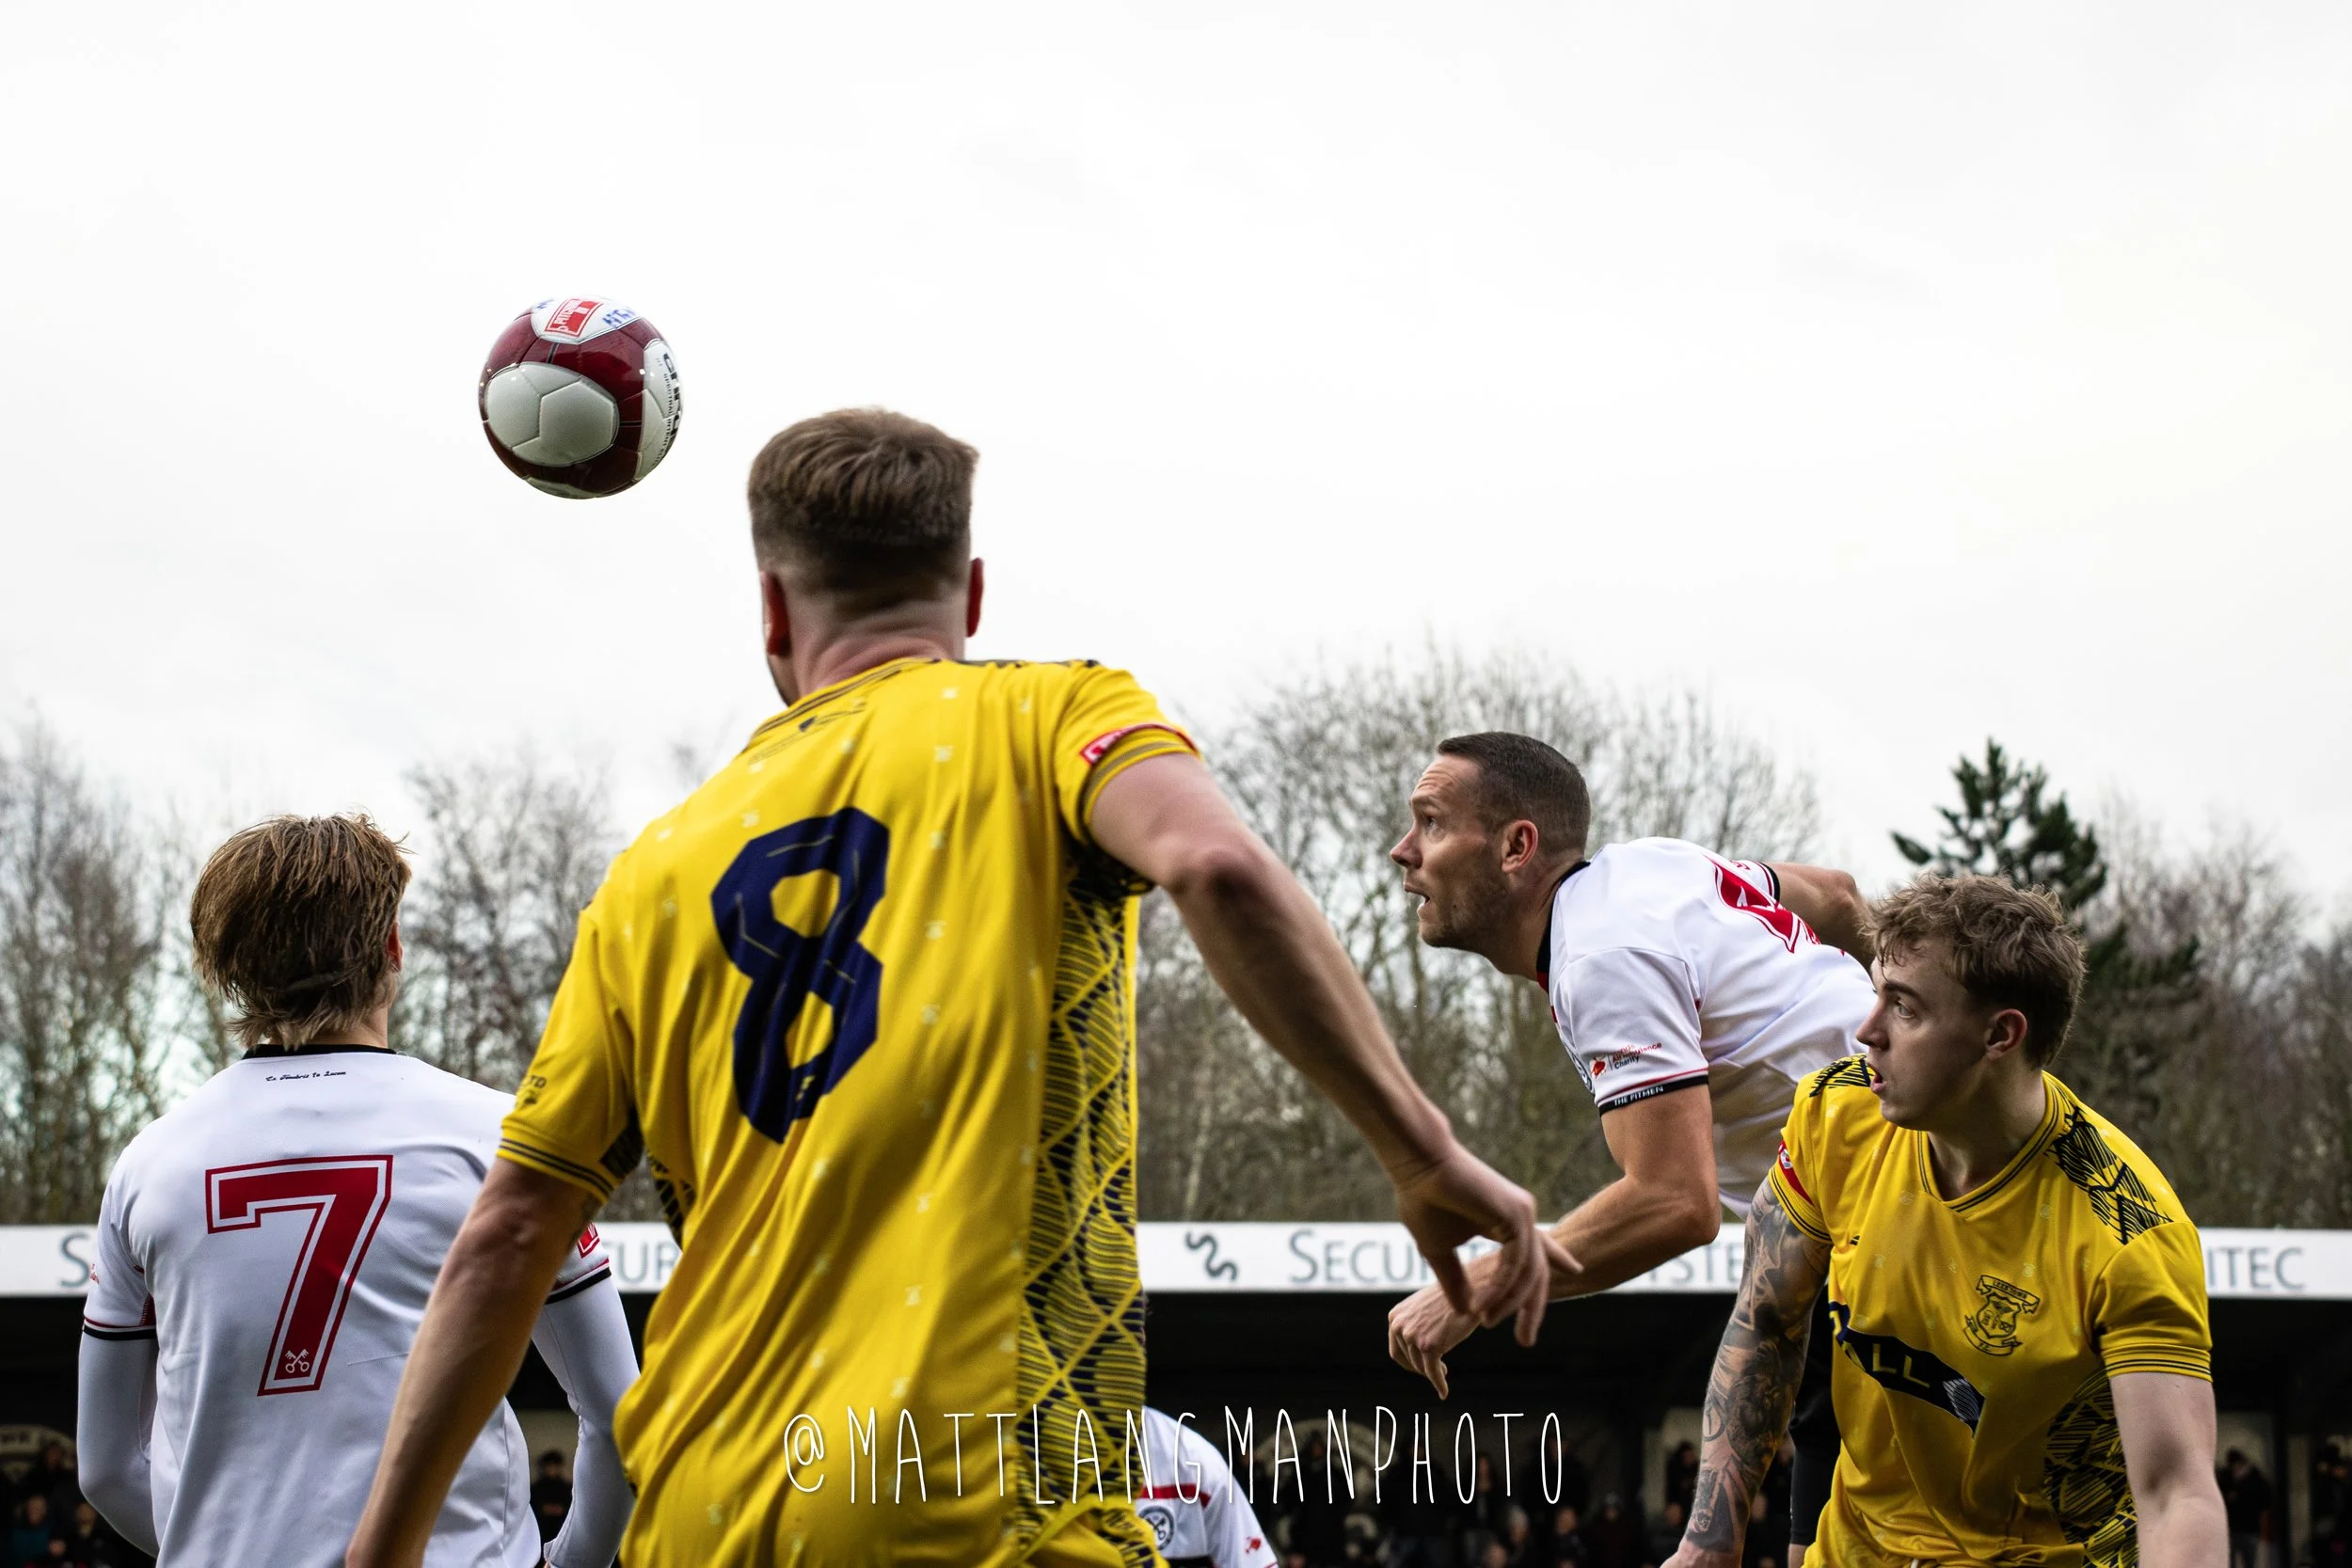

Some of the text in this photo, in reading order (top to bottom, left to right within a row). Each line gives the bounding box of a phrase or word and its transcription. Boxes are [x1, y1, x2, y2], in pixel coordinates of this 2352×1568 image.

[710, 806, 890, 1145] 8
[1613, 1096, 1629, 1106] THE
[205, 1154, 393, 1397] 7
[1288, 1227, 1430, 1285] SECU
[2206, 1246, 2306, 1291] ITEC
